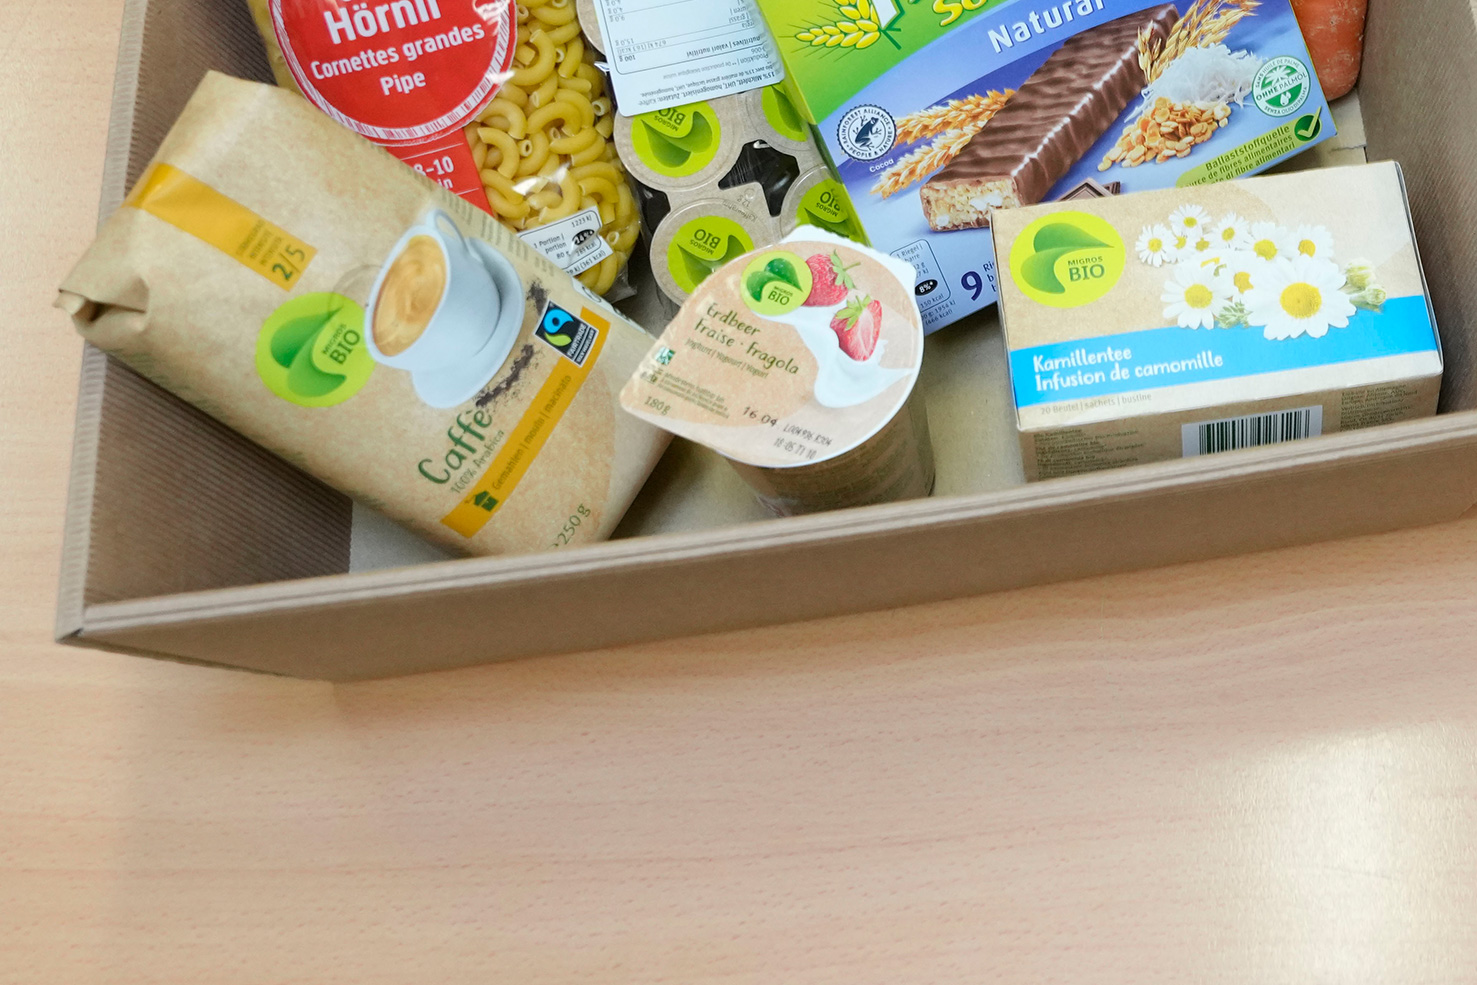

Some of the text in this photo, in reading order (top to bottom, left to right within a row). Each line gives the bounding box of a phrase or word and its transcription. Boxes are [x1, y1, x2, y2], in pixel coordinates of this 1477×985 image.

[310, 22, 485, 81] Cornettes grandes
[380, 71, 427, 96] Pipe
[1255, 86, 1278, 101] OHNE
[868, 157, 894, 173] Cocoa
[1204, 123, 1291, 172] Ballaststoffquelle
[1207, 133, 1293, 180] de fibres alimentaires
[1233, 159, 1254, 176] fibre
[1253, 141, 1296, 166] alimentari
[571, 216, 586, 228] 1223
[692, 227, 722, 251] BIO
[538, 234, 561, 247] Portion
[270, 244, 306, 281] 2/5
[1067, 255, 1104, 268] MIGROS
[1068, 263, 1106, 283] BIO
[766, 287, 791, 309] BIO
[960, 268, 983, 303] 9
[704, 299, 763, 341] Erdbeer
[328, 327, 362, 367] BIO
[565, 322, 588, 358] FAIRTRADE
[693, 316, 802, 383] Fraise Fragola
[1033, 345, 1134, 374] Kamillentee
[1035, 350, 1225, 393] Infusion de camomille
[1053, 401, 1080, 415] Beutel
[1083, 396, 1116, 411] sachets
[1122, 391, 1153, 406] bustine
[417, 407, 492, 488] Caffè
[489, 444, 526, 492] Gemahlen
[540, 370, 574, 415] macinato
[448, 423, 507, 498] 100% Arabica
[555, 511, 584, 546] 250
